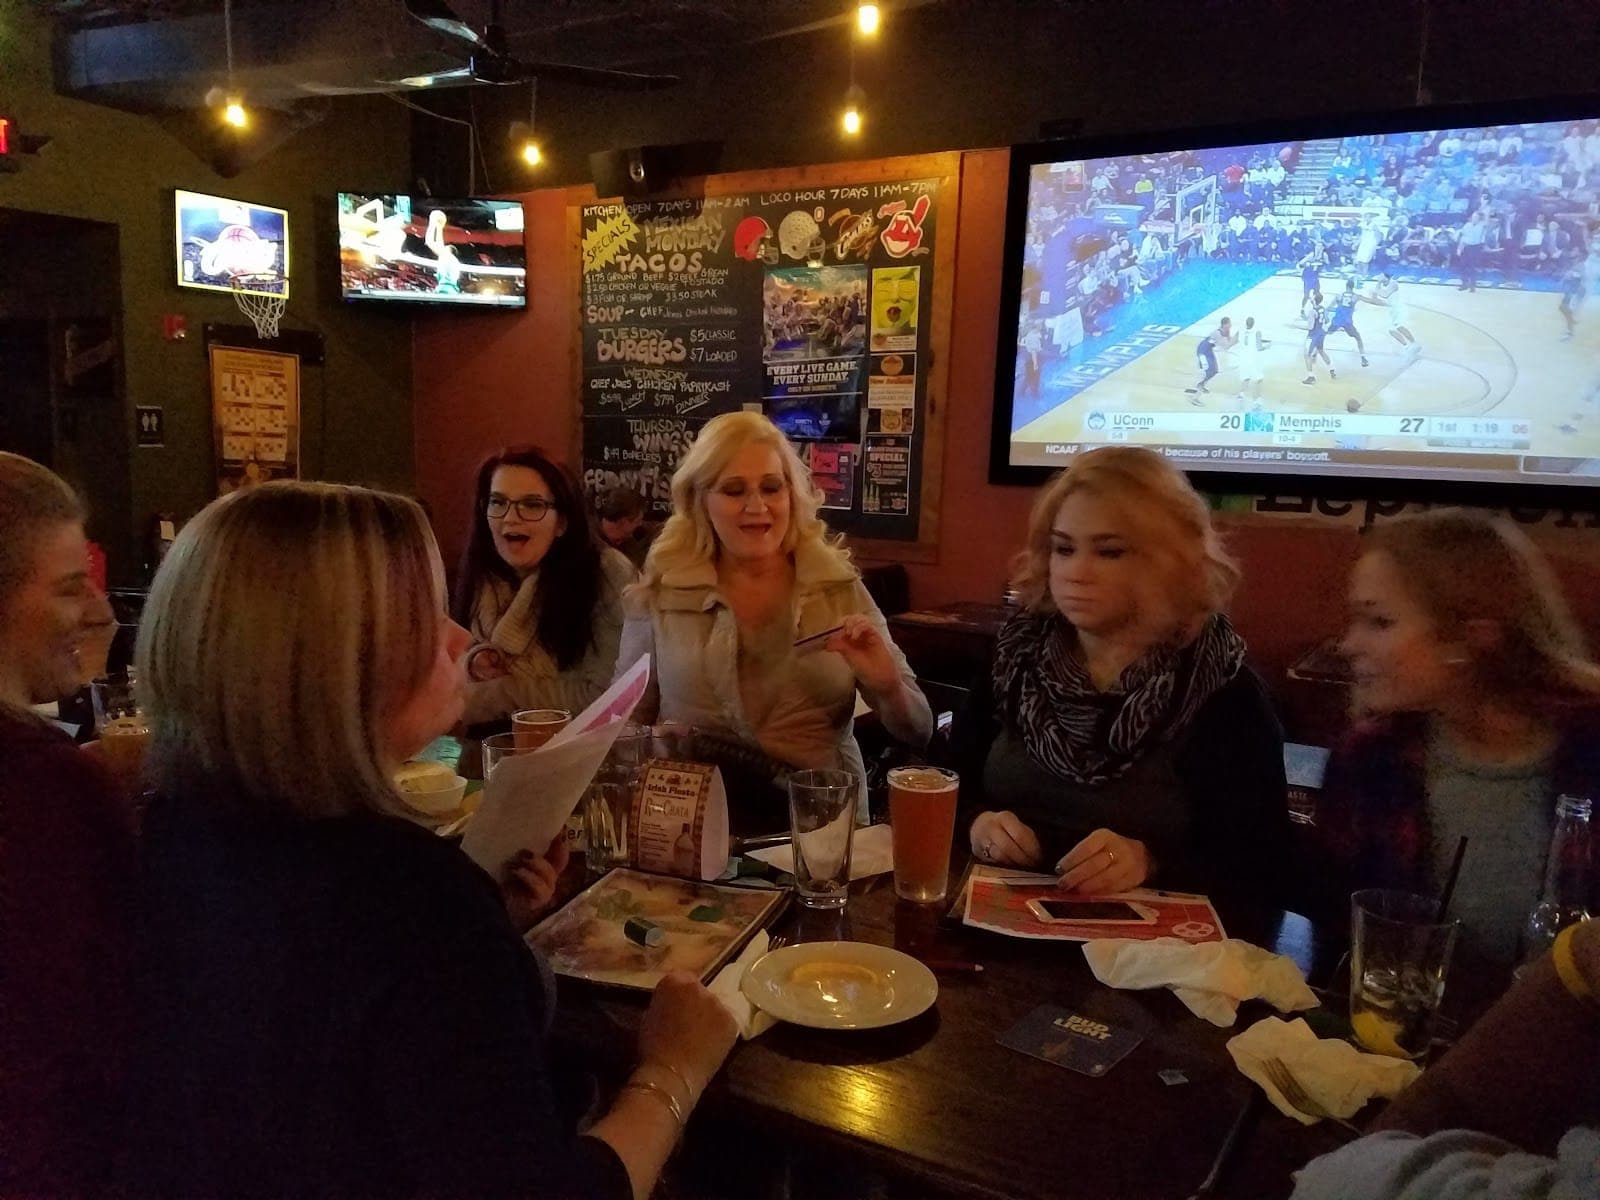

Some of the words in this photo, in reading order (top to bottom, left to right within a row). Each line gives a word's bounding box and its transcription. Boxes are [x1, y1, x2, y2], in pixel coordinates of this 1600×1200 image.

[760, 193, 791, 206] LOCO
[795, 189, 826, 203] HOUR
[584, 205, 622, 217] KITCHEN
[626, 202, 651, 214] OPEN
[586, 219, 631, 264] SPECIALS
[645, 229, 726, 254] MONDAY
[615, 251, 704, 273] TACOS
[587, 304, 625, 324] SOUP
[598, 327, 667, 341] TUESDAY
[596, 338, 687, 365] BURGERS
[623, 367, 689, 381] WEDNESDAY
[766, 364, 800, 376] EVERY
[800, 363, 825, 373] LIVE
[826, 361, 858, 372] GAME.
[773, 374, 806, 386] EVERY
[807, 371, 849, 383] SUNDAY.
[625, 419, 688, 434] THURSDAY
[1113, 414, 1154, 426] UConn
[1220, 415, 1241, 430] 20
[1280, 415, 1342, 430] Memphis
[1400, 418, 1425, 433] 27
[1045, 444, 1079, 454] NCAAF
[1165, 447, 1209, 458] because
[1211, 447, 1223, 458] of
[1224, 448, 1240, 459] his
[647, 783, 667, 793] Irish
